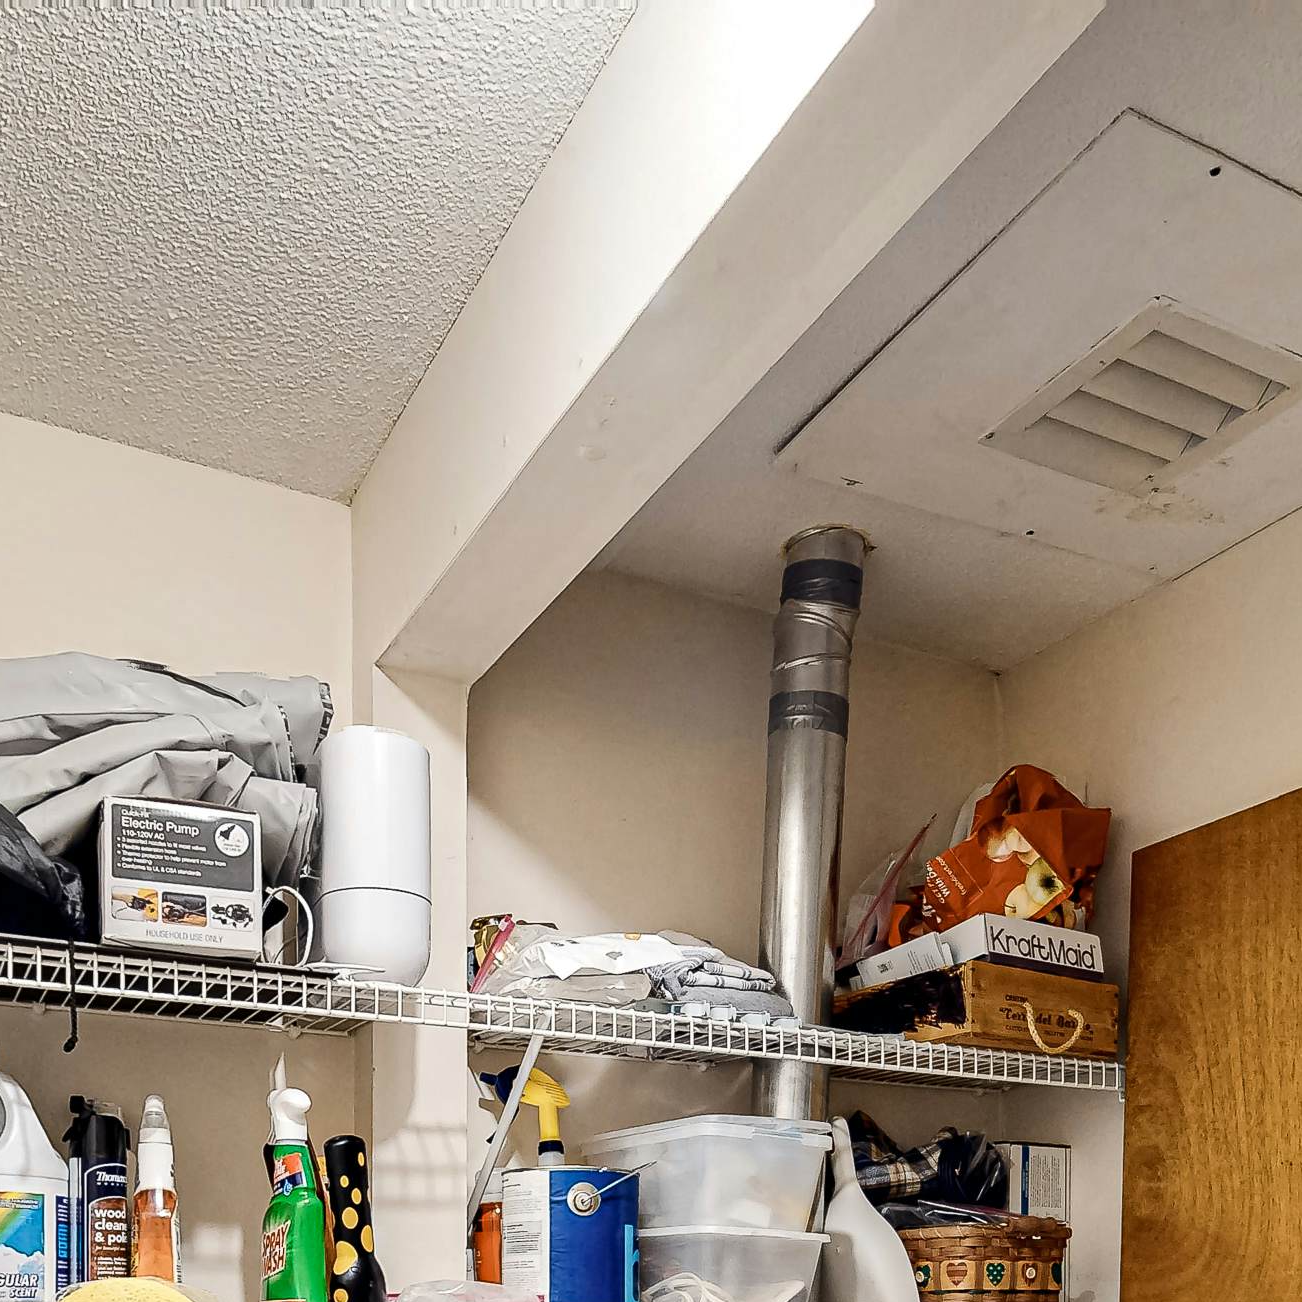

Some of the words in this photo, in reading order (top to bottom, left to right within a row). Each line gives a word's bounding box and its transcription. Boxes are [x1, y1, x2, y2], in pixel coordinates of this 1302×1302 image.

[121, 817, 164, 830] Electric
[165, 821, 200, 837] Pump
[122, 829, 153, 840] 110-120V
[153, 832, 165, 840] AC
[145, 929, 188, 940] HOUSEHOLD
[189, 933, 203, 942] USE
[204, 934, 224, 944] ONLY
[990, 925, 1096, 970] KraftMaid
[94, 1208, 126, 1219] wood
[95, 1232, 105, 1243] &
[9, 1287, 38, 1299] SCENT
